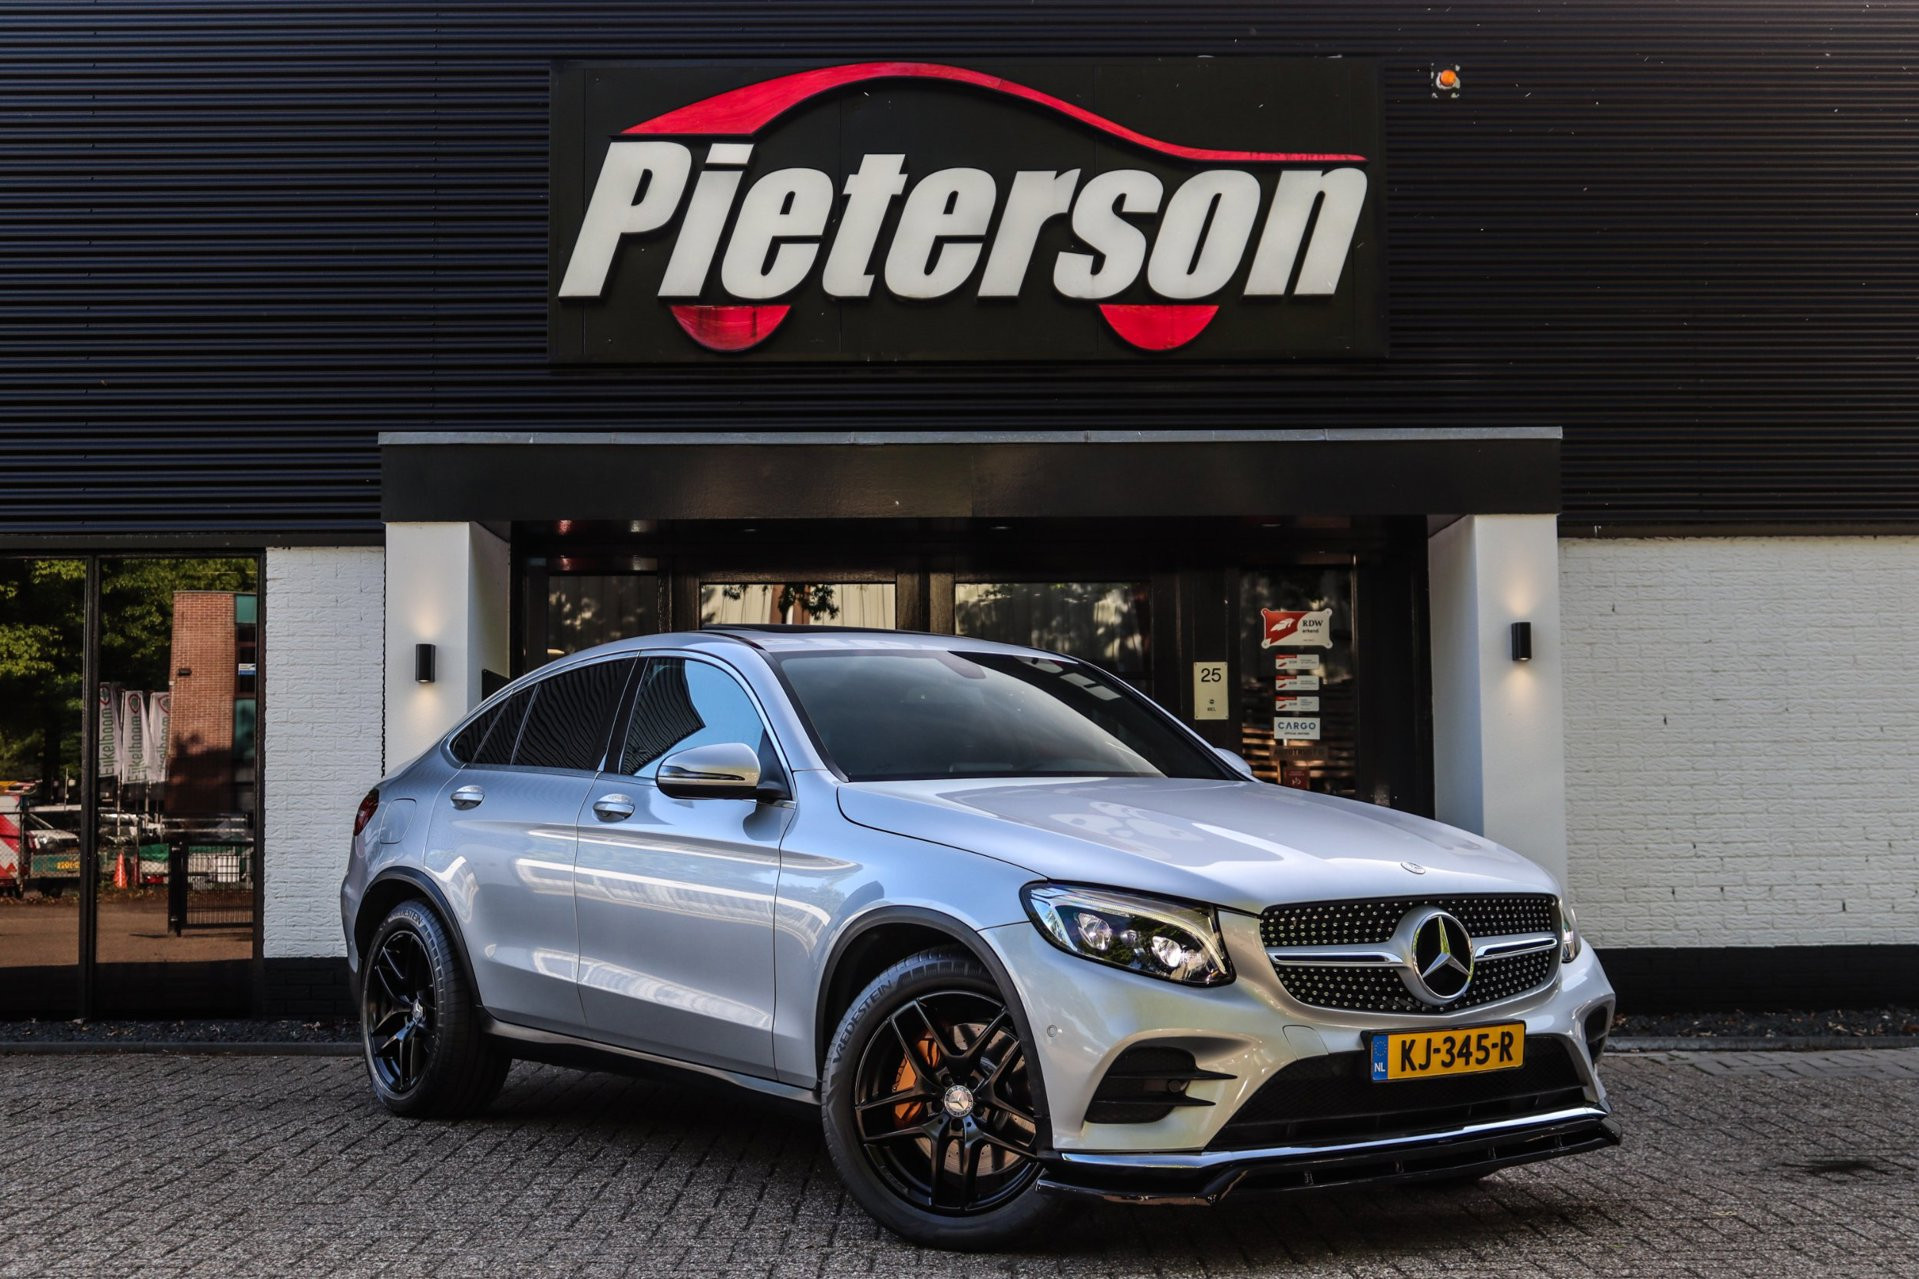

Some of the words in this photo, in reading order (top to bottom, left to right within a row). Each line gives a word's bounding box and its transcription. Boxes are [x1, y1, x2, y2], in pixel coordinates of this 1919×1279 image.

[557, 140, 1369, 300] Pieterson
[1302, 619, 1323, 627] RDW
[1201, 667, 1222, 683] 25
[1277, 721, 1317, 730] CARGO
[100, 708, 118, 776] Eijkelboom
[832, 980, 892, 1064] VREDESTEIN
[1401, 1031, 1514, 1072] KJ-345-R
[1374, 1062, 1386, 1072] NL
